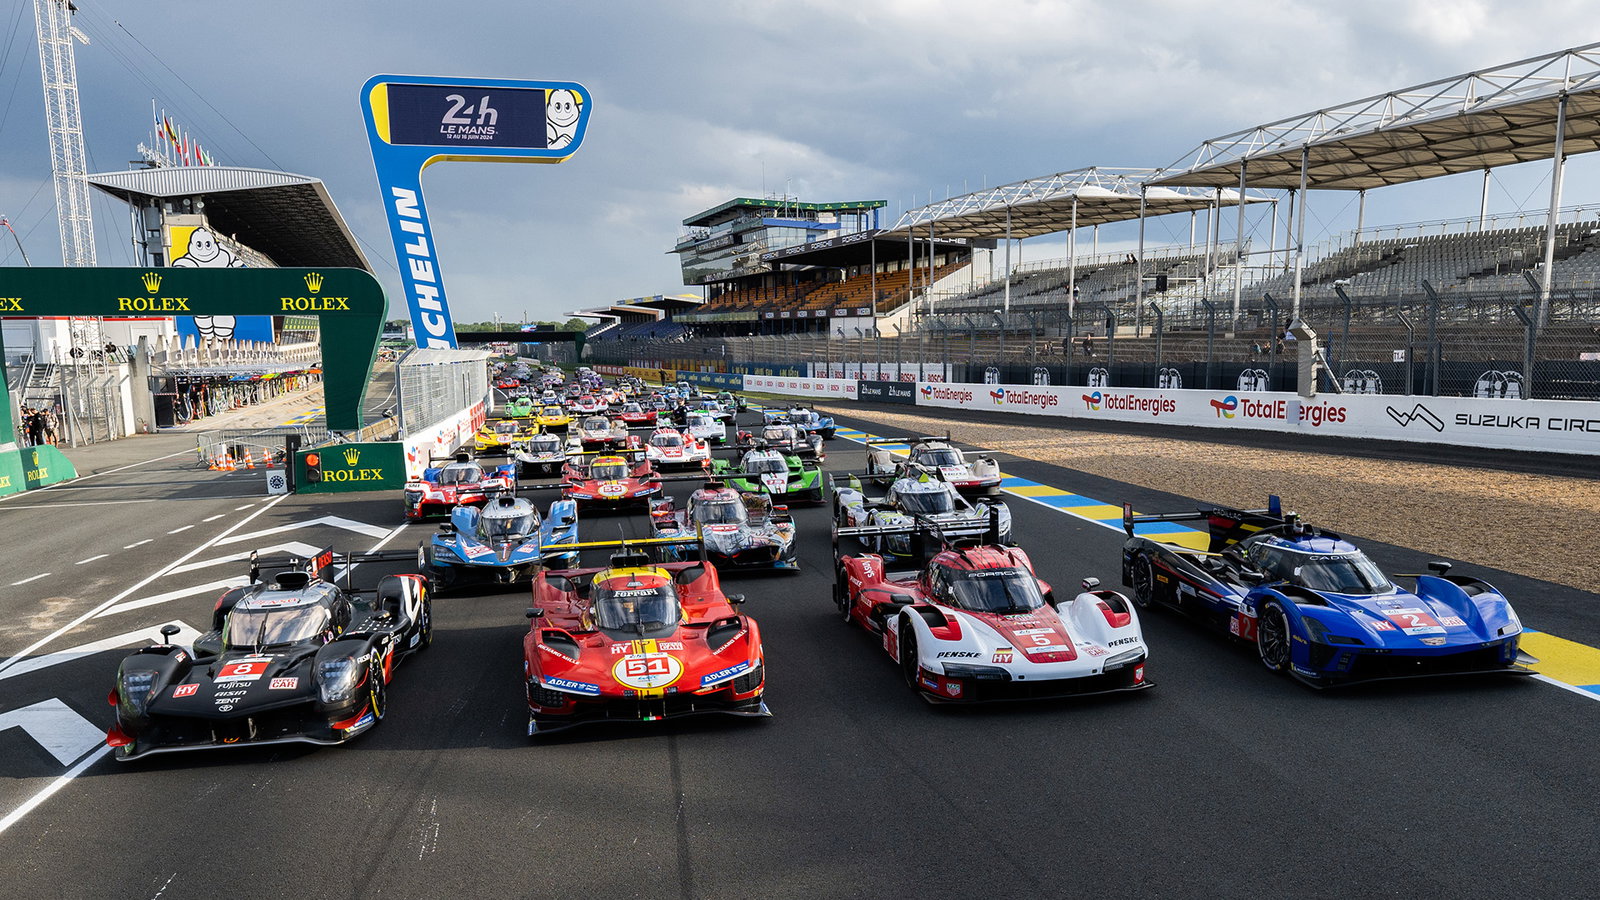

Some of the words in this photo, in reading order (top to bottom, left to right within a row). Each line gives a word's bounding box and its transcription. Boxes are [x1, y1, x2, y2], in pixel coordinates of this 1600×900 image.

[442, 94, 498, 125] 24h
[440, 125, 456, 134] LE
[458, 126, 495, 134] MANS
[842, 233, 868, 244] PORSCHE
[810, 240, 833, 250] PORSCHE
[391, 186, 450, 348] ICHELIN
[118, 298, 190, 311] ROLEX
[280, 297, 350, 310] ROLEX
[900, 373, 916, 382] BOSCH
[927, 374, 944, 382] BOSCH
[933, 388, 973, 404] TotalEnergies
[1006, 390, 1058, 409] TotalEnergies
[1104, 394, 1176, 416] TotalEnergies
[1240, 399, 1346, 426] TotalEergies
[1455, 414, 1540, 430] SUZUKA
[27, 468, 48, 482] ROLEX
[323, 468, 384, 482] ROLEX
[1213, 508, 1242, 520] CADILLAC
[613, 588, 658, 598] Ferrari
[1376, 622, 1391, 630] HY
[1402, 615, 1427, 627] 2
[1242, 616, 1254, 640] 2
[1031, 634, 1051, 645] 5
[1108, 636, 1138, 648] PENSKE
[538, 644, 562, 658] RICHARD
[611, 646, 628, 654] HY
[713, 639, 735, 656] RICHARD
[993, 655, 1012, 663] HY
[233, 664, 252, 674] 8
[628, 660, 668, 674] 51
[704, 670, 731, 683] ADLER
[547, 678, 578, 689] ADLER
[175, 686, 197, 696] HY
